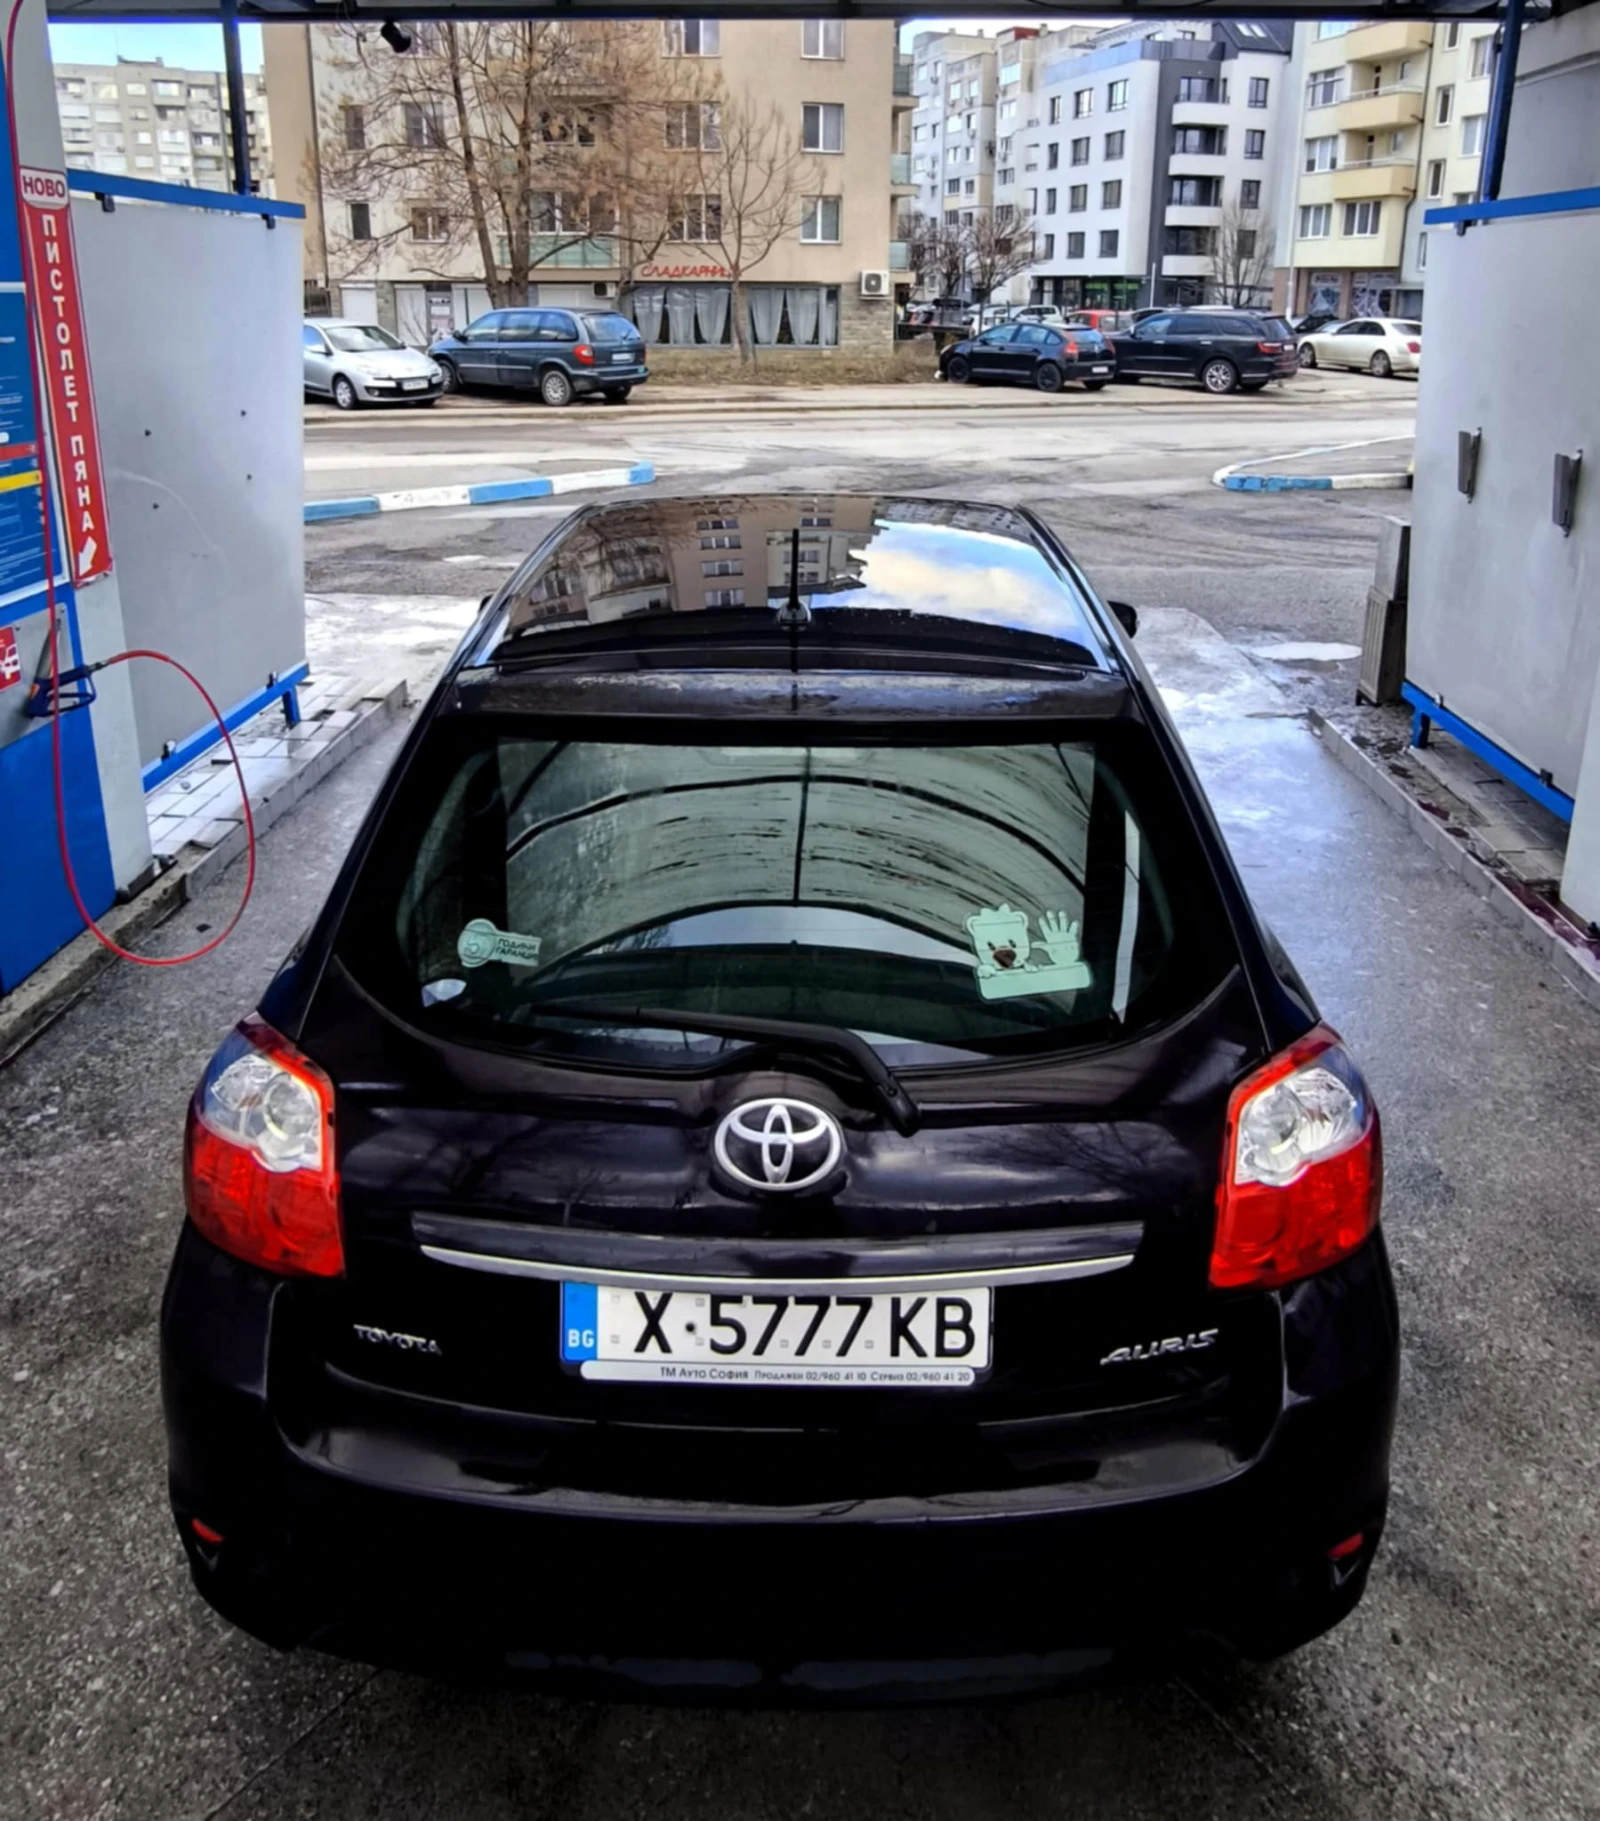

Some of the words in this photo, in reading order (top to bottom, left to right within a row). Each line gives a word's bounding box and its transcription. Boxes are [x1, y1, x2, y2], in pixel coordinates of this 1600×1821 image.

[22, 175, 66, 198] НОВО
[42, 214, 79, 423] ПИСТОЛЕТ
[70, 434, 95, 532] ПЯНА
[353, 1324, 443, 1356] TOYOTA
[568, 1329, 595, 1348] BG
[634, 1292, 673, 1353] X
[710, 1294, 872, 1357] 5777
[890, 1297, 976, 1358] KB
[1099, 1328, 1219, 1365] AURIS
[805, 1371, 841, 1382] 02/960
[906, 1371, 941, 1382] 02/960
[958, 1371, 970, 1382] 20
